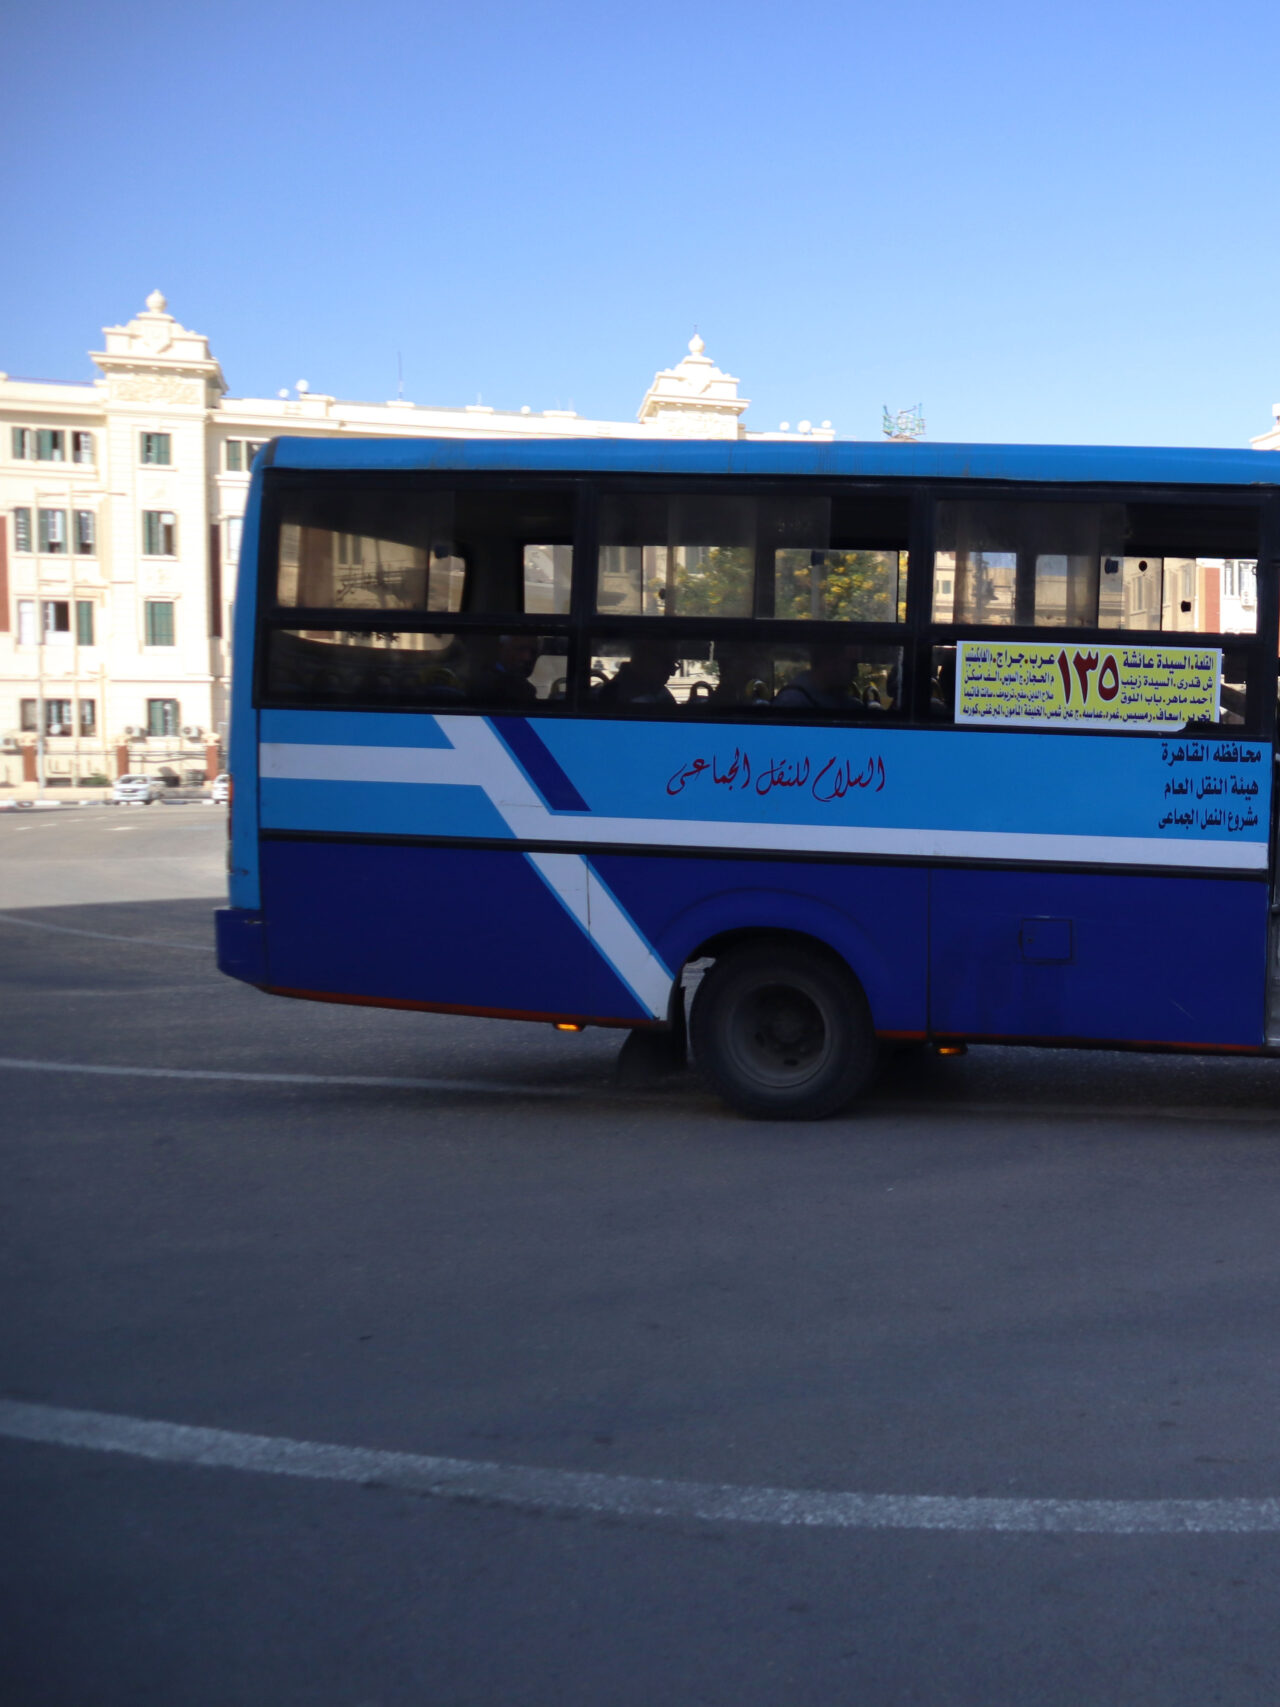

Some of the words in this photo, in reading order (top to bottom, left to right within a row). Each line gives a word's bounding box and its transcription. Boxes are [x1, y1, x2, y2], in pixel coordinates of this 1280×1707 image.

[1161, 741, 1209, 767] القاهرة
[755, 755, 811, 796] للنقل
[811, 754, 886, 803] السلام
[1164, 777, 1193, 800] العام
[1196, 775, 1228, 799] النقل
[1230, 775, 1259, 801] هيئة
